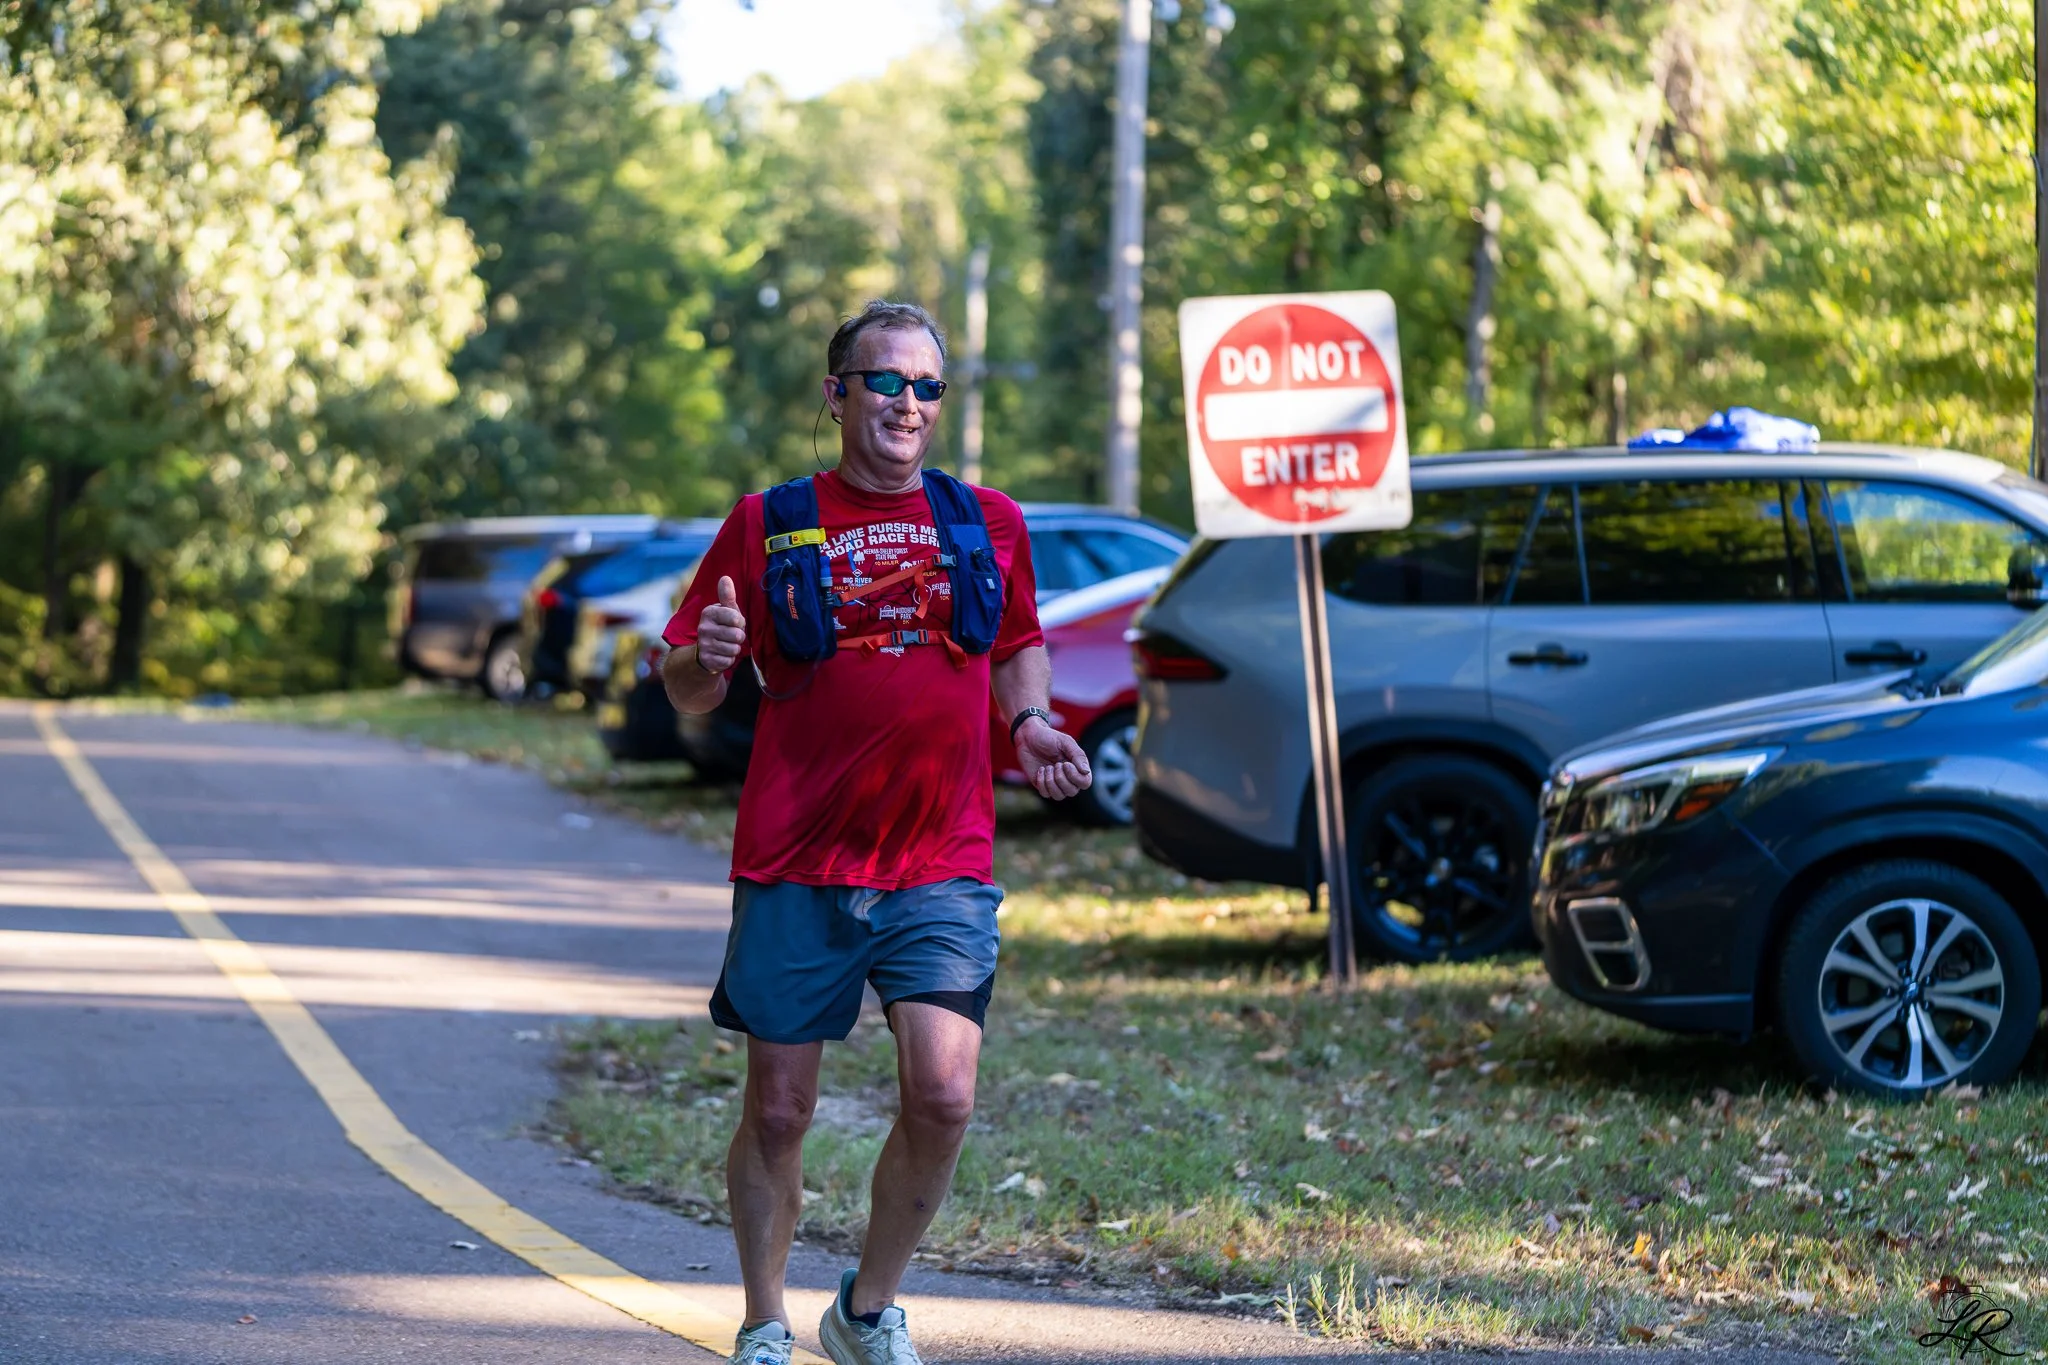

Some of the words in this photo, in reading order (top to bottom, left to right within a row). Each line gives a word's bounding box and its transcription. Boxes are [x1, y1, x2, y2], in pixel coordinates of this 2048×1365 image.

[1218, 344, 1272, 386] DO
[1290, 339, 1365, 383] NOT
[1240, 441, 1361, 487] ENTER
[826, 538, 865, 560] ROAD
[868, 533, 906, 546] RACE
[831, 527, 865, 547] LANE
[867, 522, 917, 535] PURSER
